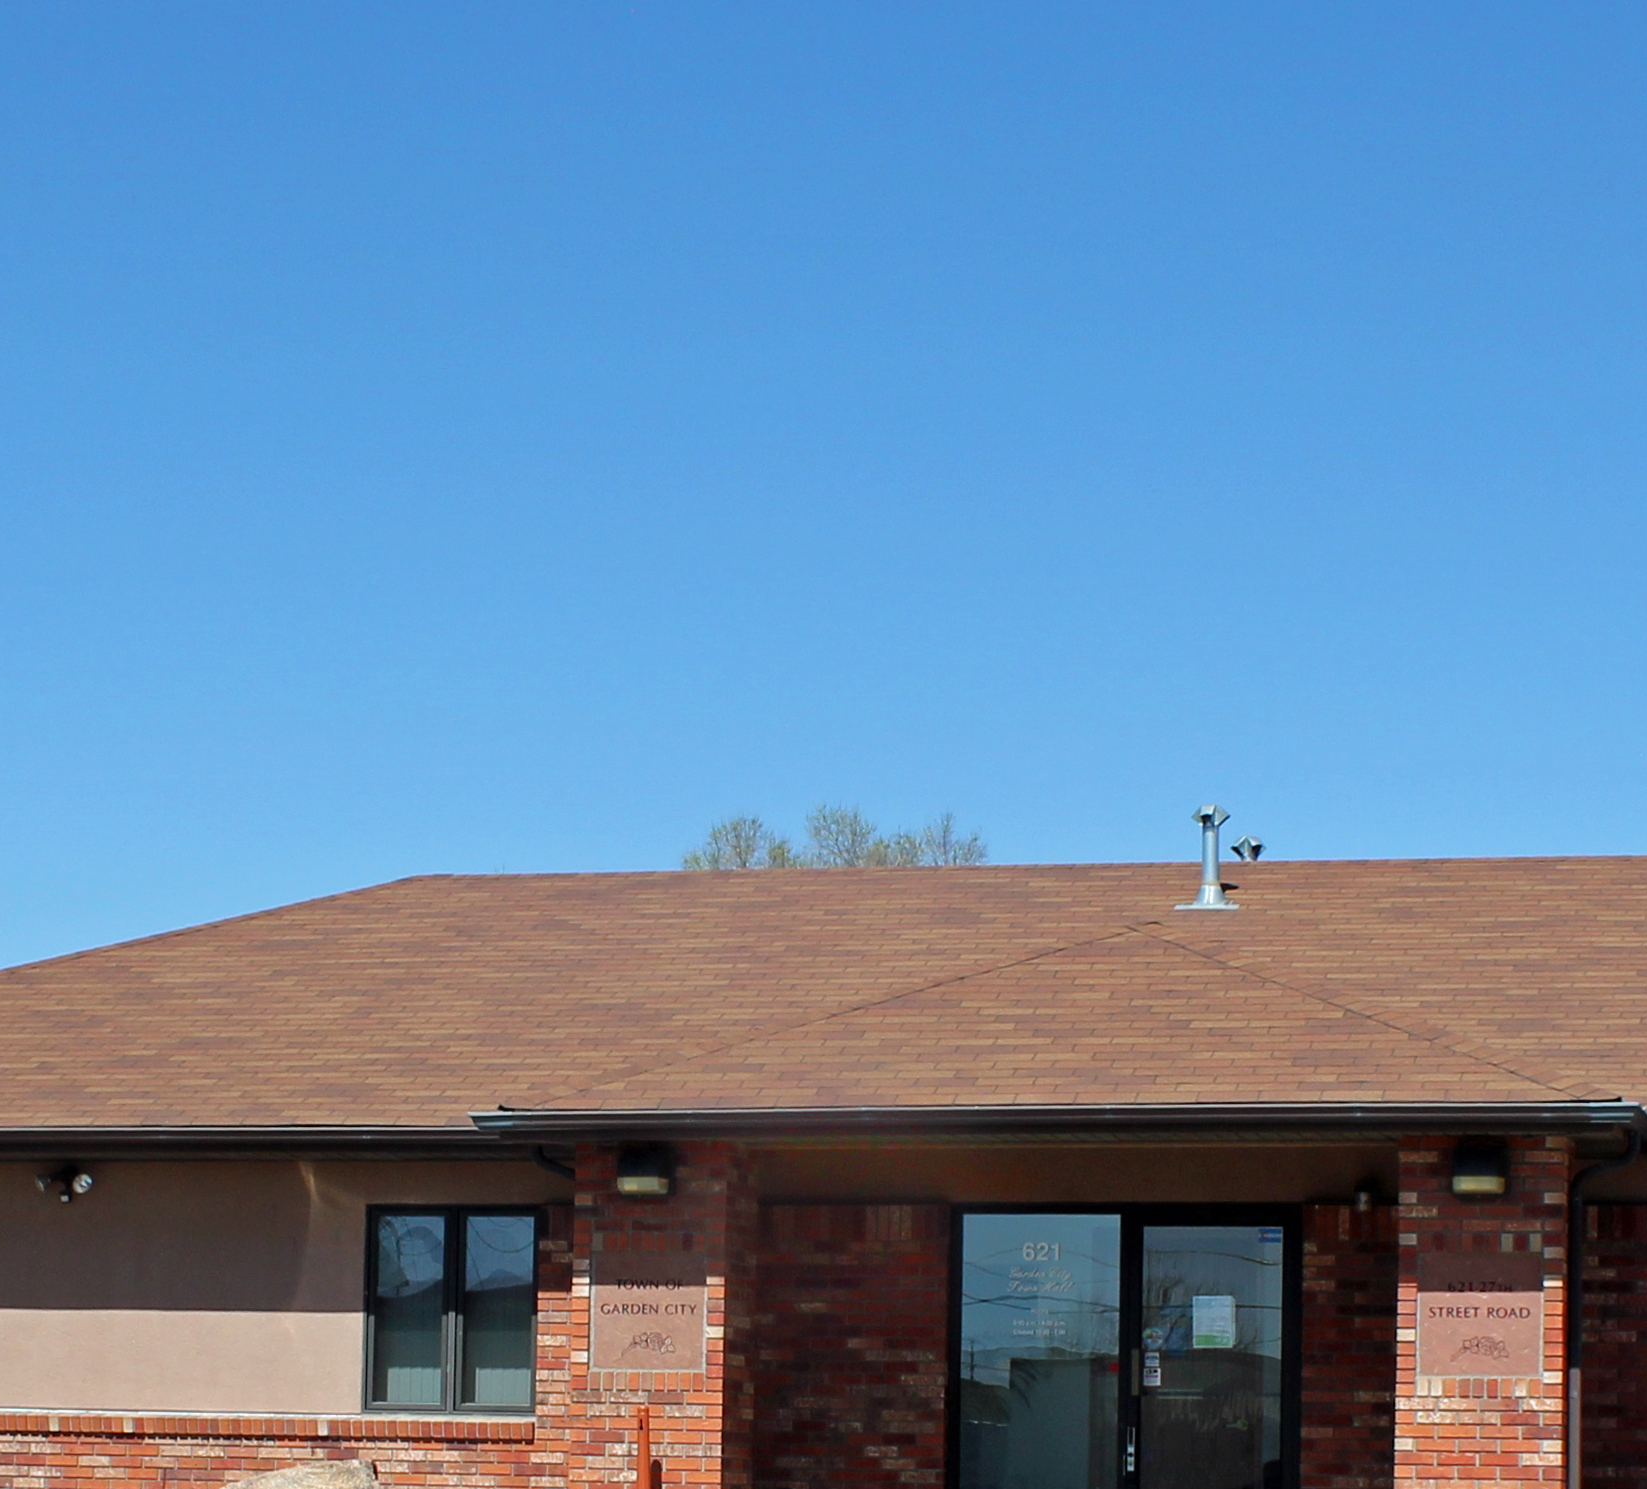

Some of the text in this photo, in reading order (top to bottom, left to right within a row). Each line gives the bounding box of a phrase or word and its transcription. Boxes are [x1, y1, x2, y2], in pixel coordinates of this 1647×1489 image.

[1023, 1242, 1061, 1261] 621
[616, 1279, 684, 1290] TOWN OF
[1447, 1281, 1475, 1292] 621
[600, 1303, 698, 1315] GARDEN CITY
[1428, 1307, 1531, 1319] STREET ROAD
